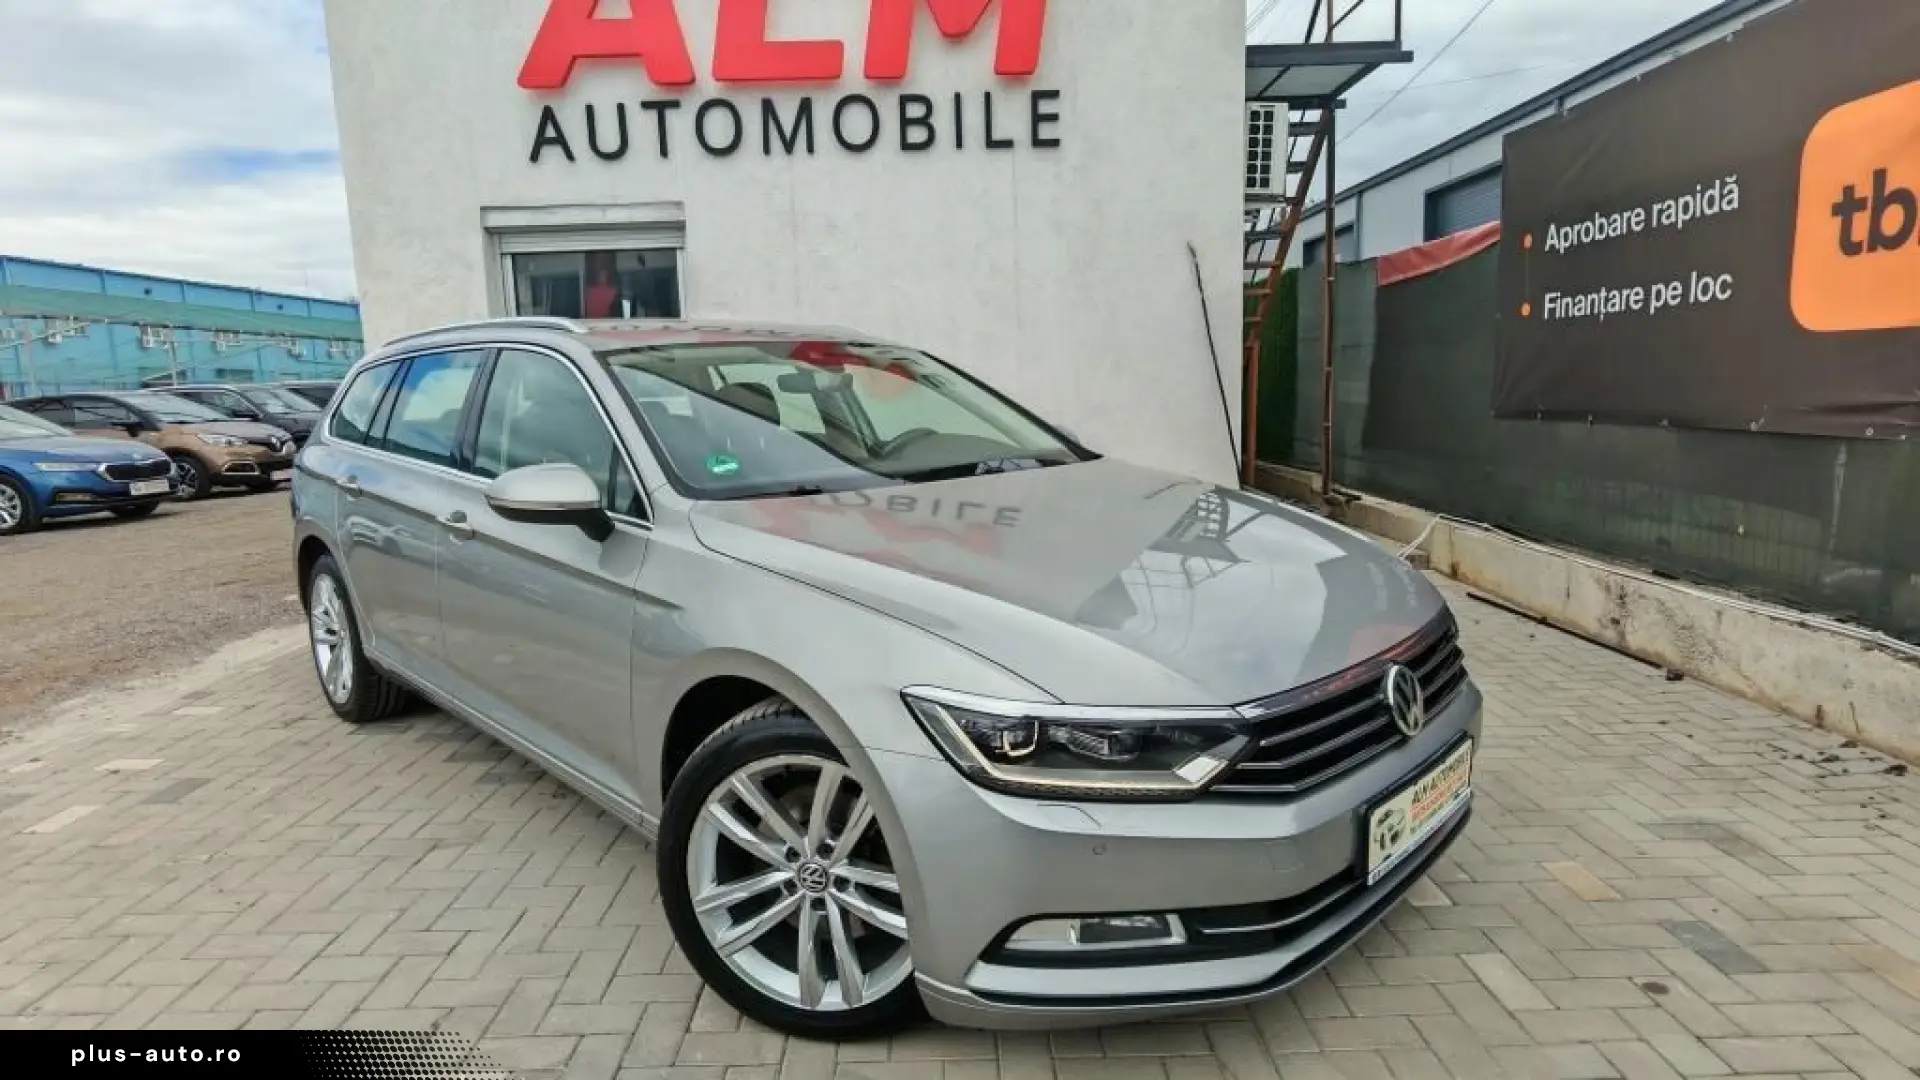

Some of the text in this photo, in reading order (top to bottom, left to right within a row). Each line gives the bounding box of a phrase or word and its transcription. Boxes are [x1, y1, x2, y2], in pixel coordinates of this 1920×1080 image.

[517, 0, 1047, 90] ALM
[530, 88, 1061, 163] AUTOMOBILE
[1544, 174, 1739, 255] Aprobare rapidă
[1831, 168, 1920, 256] tb
[1544, 270, 1733, 322] Finanțare pe loc
